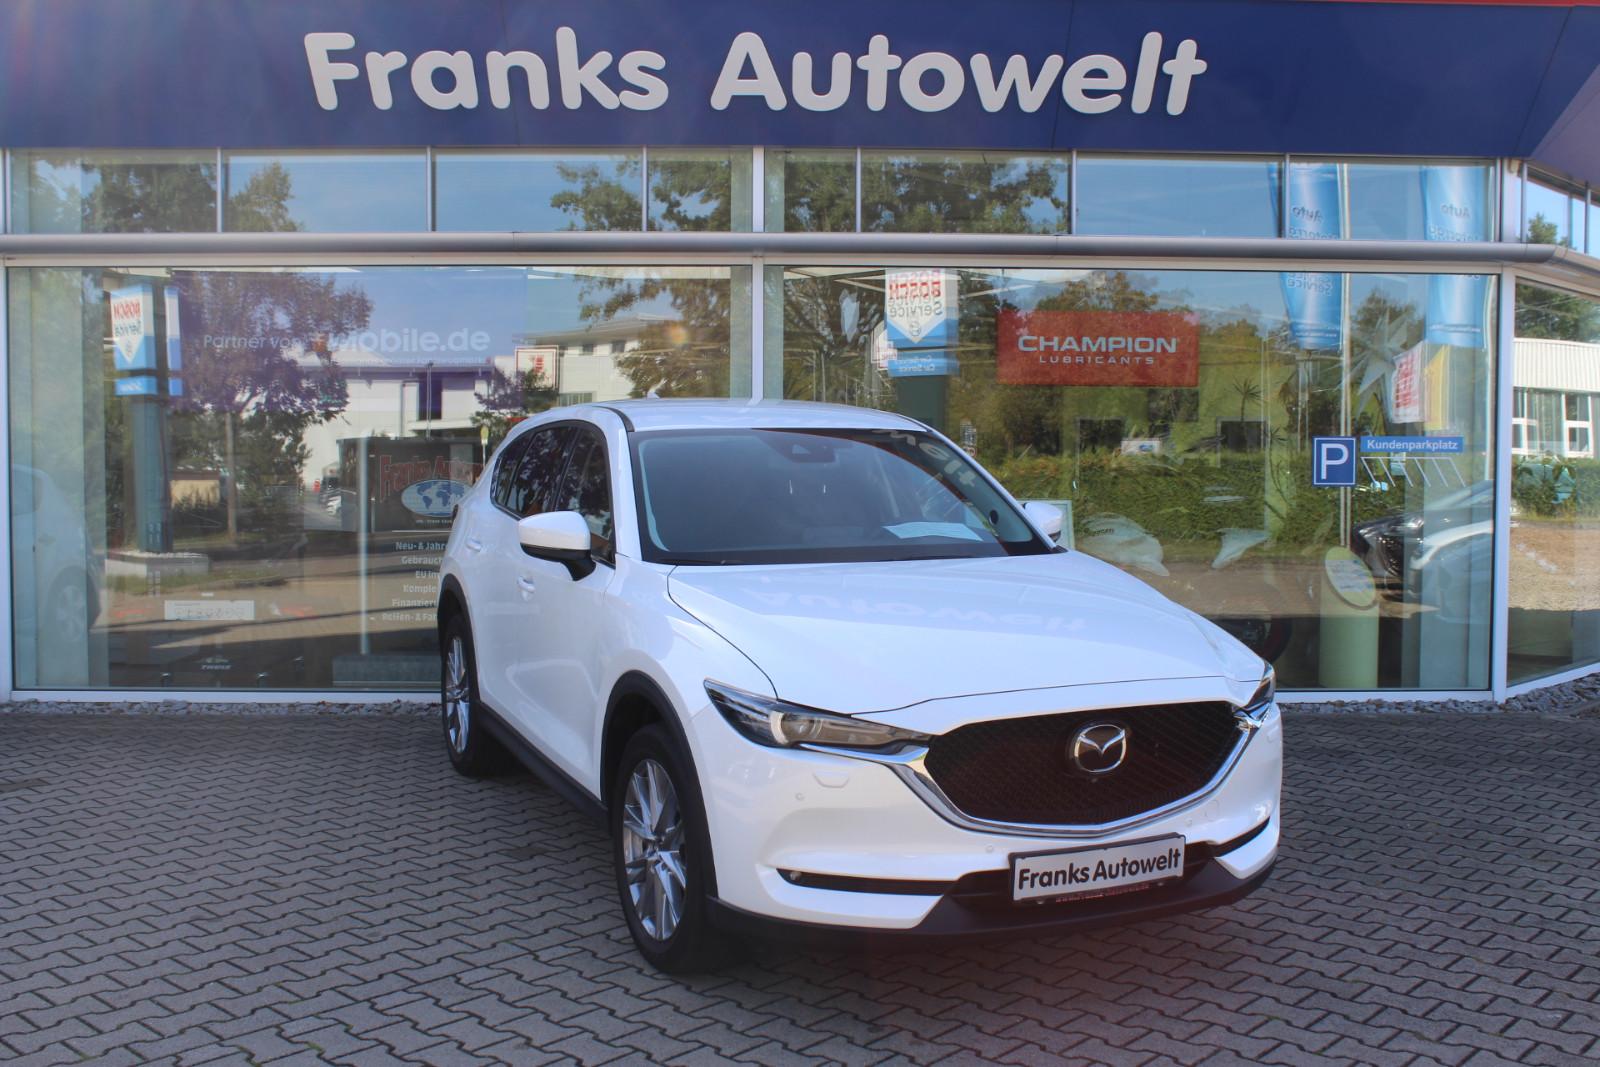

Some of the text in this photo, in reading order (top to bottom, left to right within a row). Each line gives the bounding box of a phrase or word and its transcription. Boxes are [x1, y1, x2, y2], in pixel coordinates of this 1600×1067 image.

[303, 26, 1208, 116] Franks Autowelt
[203, 335, 265, 350] Partner
[1018, 335, 1177, 353] CHAMPION
[1039, 355, 1155, 365] LUBRICANTS
[1367, 439, 1458, 451] Kundenparkplatz
[1320, 442, 1349, 480] P
[1018, 848, 1182, 890] Franks Autowelt
